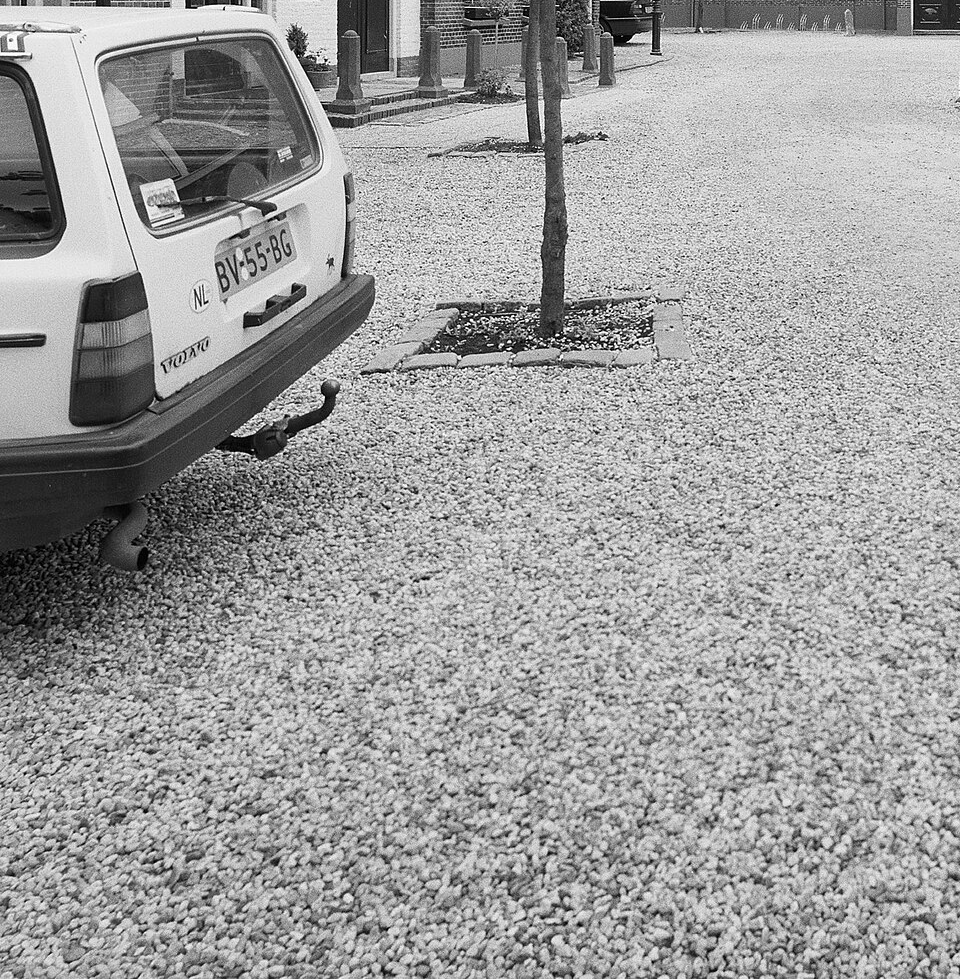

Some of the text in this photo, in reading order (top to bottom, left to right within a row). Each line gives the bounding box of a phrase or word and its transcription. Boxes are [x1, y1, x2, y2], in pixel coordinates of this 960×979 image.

[214, 228, 293, 294] BV-55-BG
[193, 283, 209, 311] NL
[160, 335, 211, 374] VOLVO
